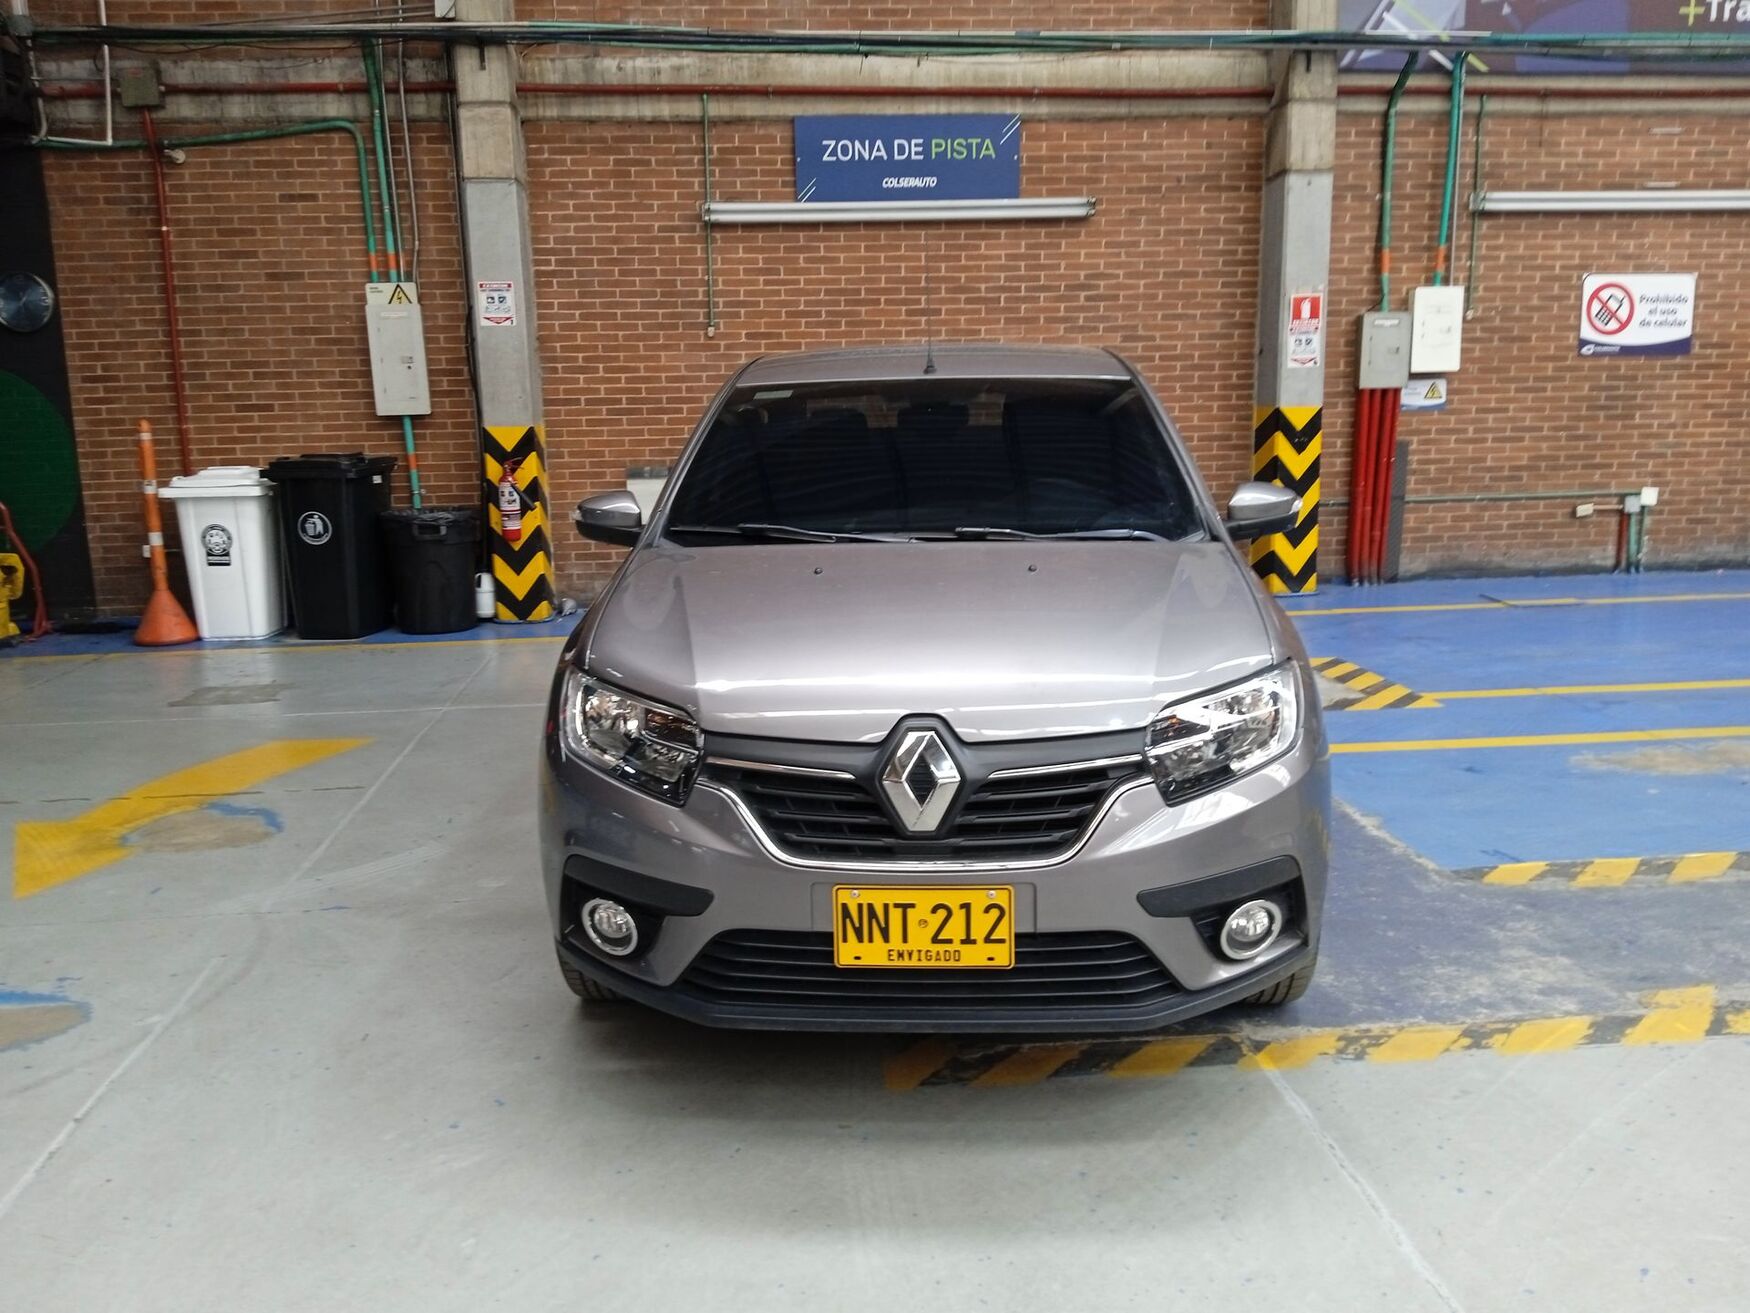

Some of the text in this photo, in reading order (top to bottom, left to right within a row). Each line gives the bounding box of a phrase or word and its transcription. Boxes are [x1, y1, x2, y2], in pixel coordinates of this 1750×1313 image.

[822, 138, 996, 161] ZONA DE PISTA
[882, 176, 938, 188] COLSERAUTO
[1639, 294, 1689, 304] Prohibido
[1648, 307, 1678, 316] el uso
[1639, 318, 1688, 328] de celular
[840, 902, 1007, 945] NNT 212
[887, 949, 962, 962] ENVIGADO
